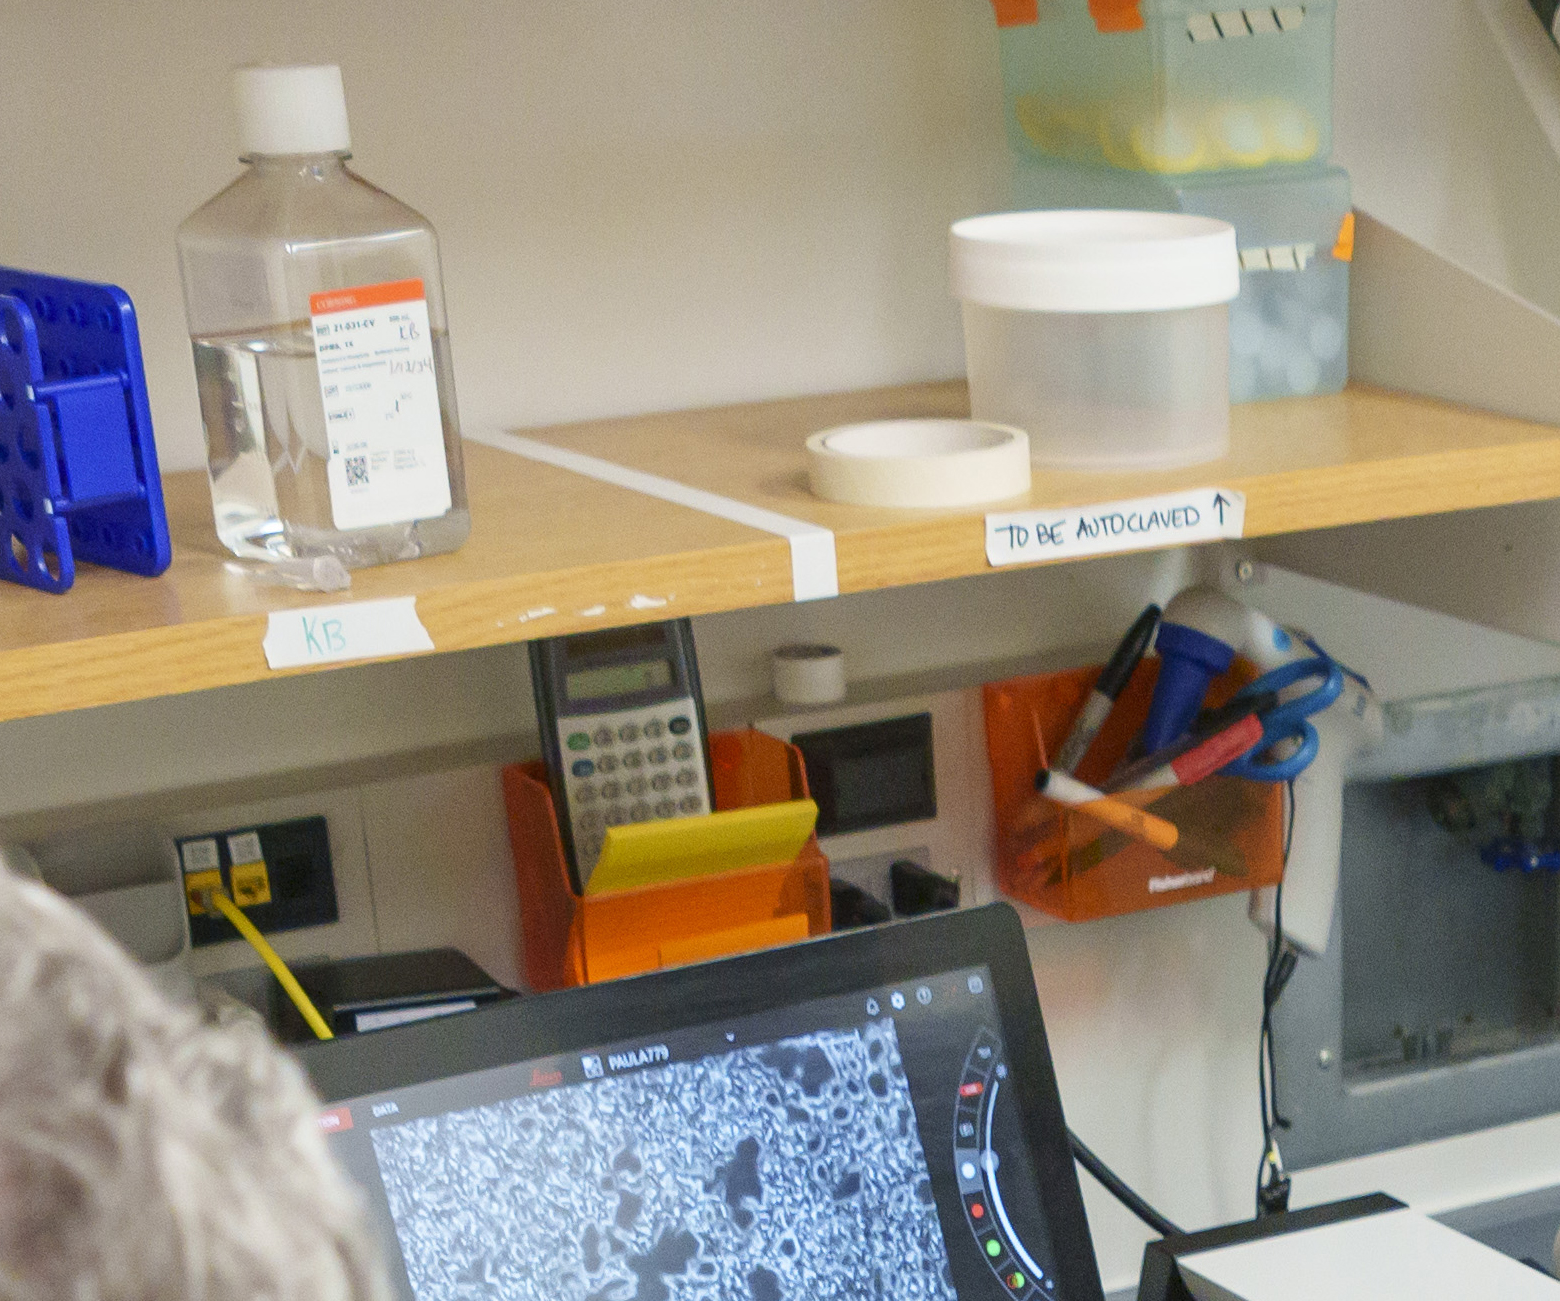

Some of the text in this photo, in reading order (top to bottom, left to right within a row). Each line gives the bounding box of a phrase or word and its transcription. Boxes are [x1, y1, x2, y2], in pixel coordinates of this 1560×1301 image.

[994, 506, 1200, 549] TO BE AUTOCLAVED
[302, 615, 346, 656] KB
[371, 1102, 399, 1118] DATA
